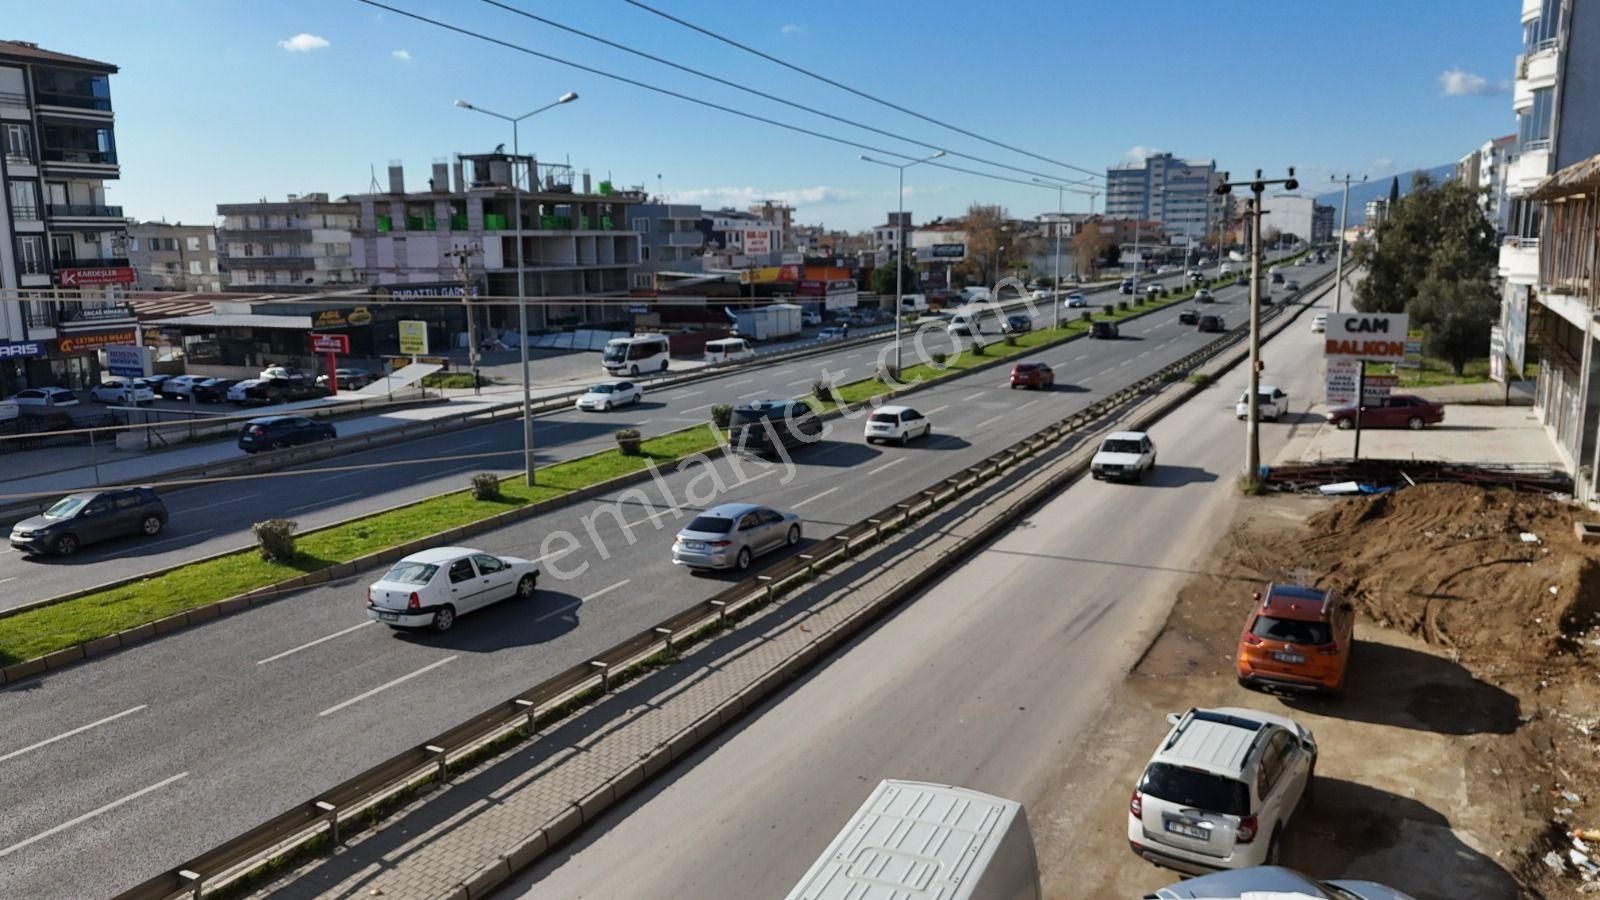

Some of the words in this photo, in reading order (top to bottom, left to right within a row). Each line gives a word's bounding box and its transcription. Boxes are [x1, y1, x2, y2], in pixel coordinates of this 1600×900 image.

[441, 286, 479, 299] GARAE
[1344, 318, 1389, 333] CAM
[1326, 339, 1405, 356] BALKON
